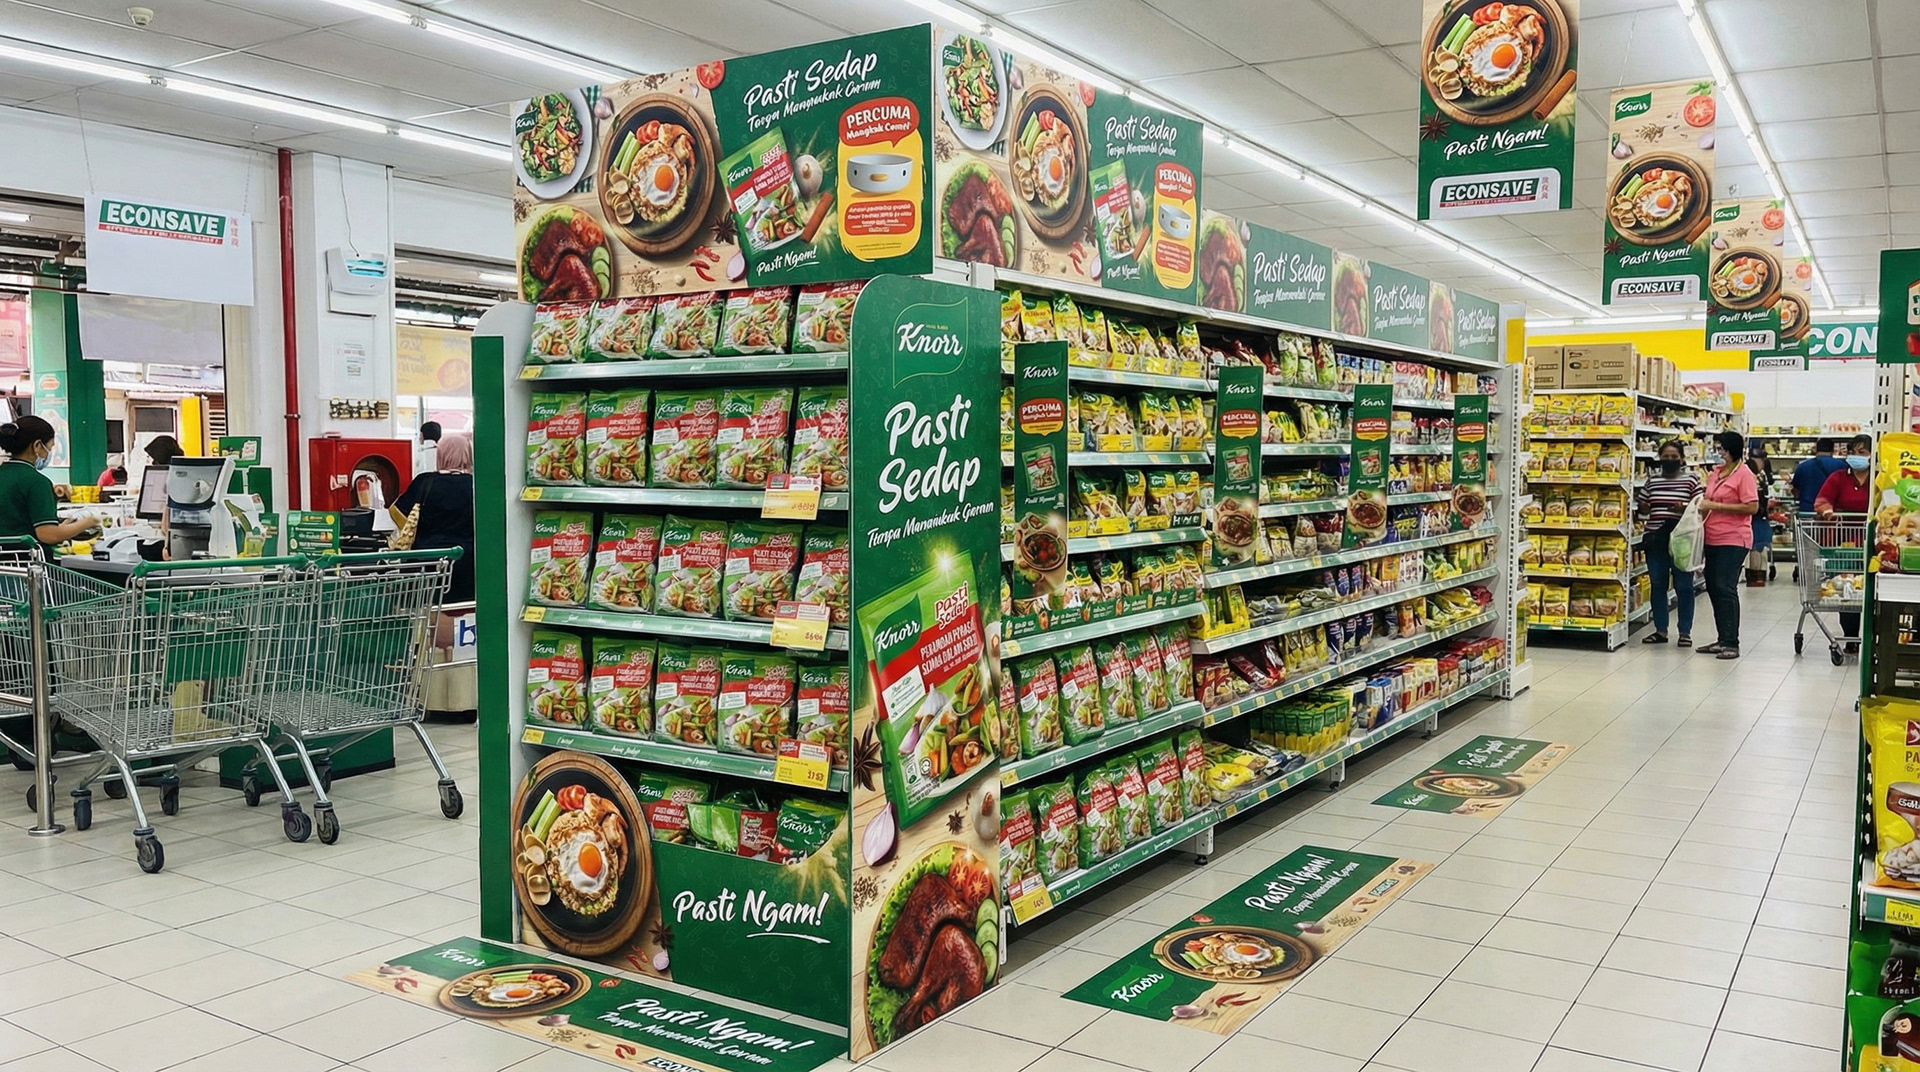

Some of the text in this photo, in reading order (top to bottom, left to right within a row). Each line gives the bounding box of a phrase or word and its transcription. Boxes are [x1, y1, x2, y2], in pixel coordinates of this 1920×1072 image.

[743, 49, 878, 116] Pasti Sedap
[846, 105, 911, 129] PERCUMA
[1104, 114, 1178, 147] Pasti Sedap
[1444, 123, 1550, 161] Pasti Ngam!
[1445, 180, 1534, 202] ECONSAVE
[106, 202, 220, 236] ECONSAVE
[1253, 251, 1326, 290] Pasti Sedap
[1619, 244, 1692, 269] Pasti Ngam!
[1373, 285, 1426, 317] Pasti Sedap
[1620, 281, 1682, 295] ECONSAVE
[897, 321, 963, 356] Knorr
[1023, 365, 1060, 379] Knorr
[1225, 384, 1257, 394] Knorr
[884, 393, 973, 456] Pasti
[1022, 403, 1061, 415] PERCUMA
[878, 446, 981, 514] Sedap
[874, 620, 921, 653] Knorr
[1244, 880, 1297, 912] Pasti
[1278, 853, 1335, 886] Ngam!
[673, 888, 830, 933] Pasti Ngam!
[1111, 972, 1164, 1003] Knorr
[617, 998, 709, 1026] Pasti
[695, 1017, 816, 1053] Ngam!
